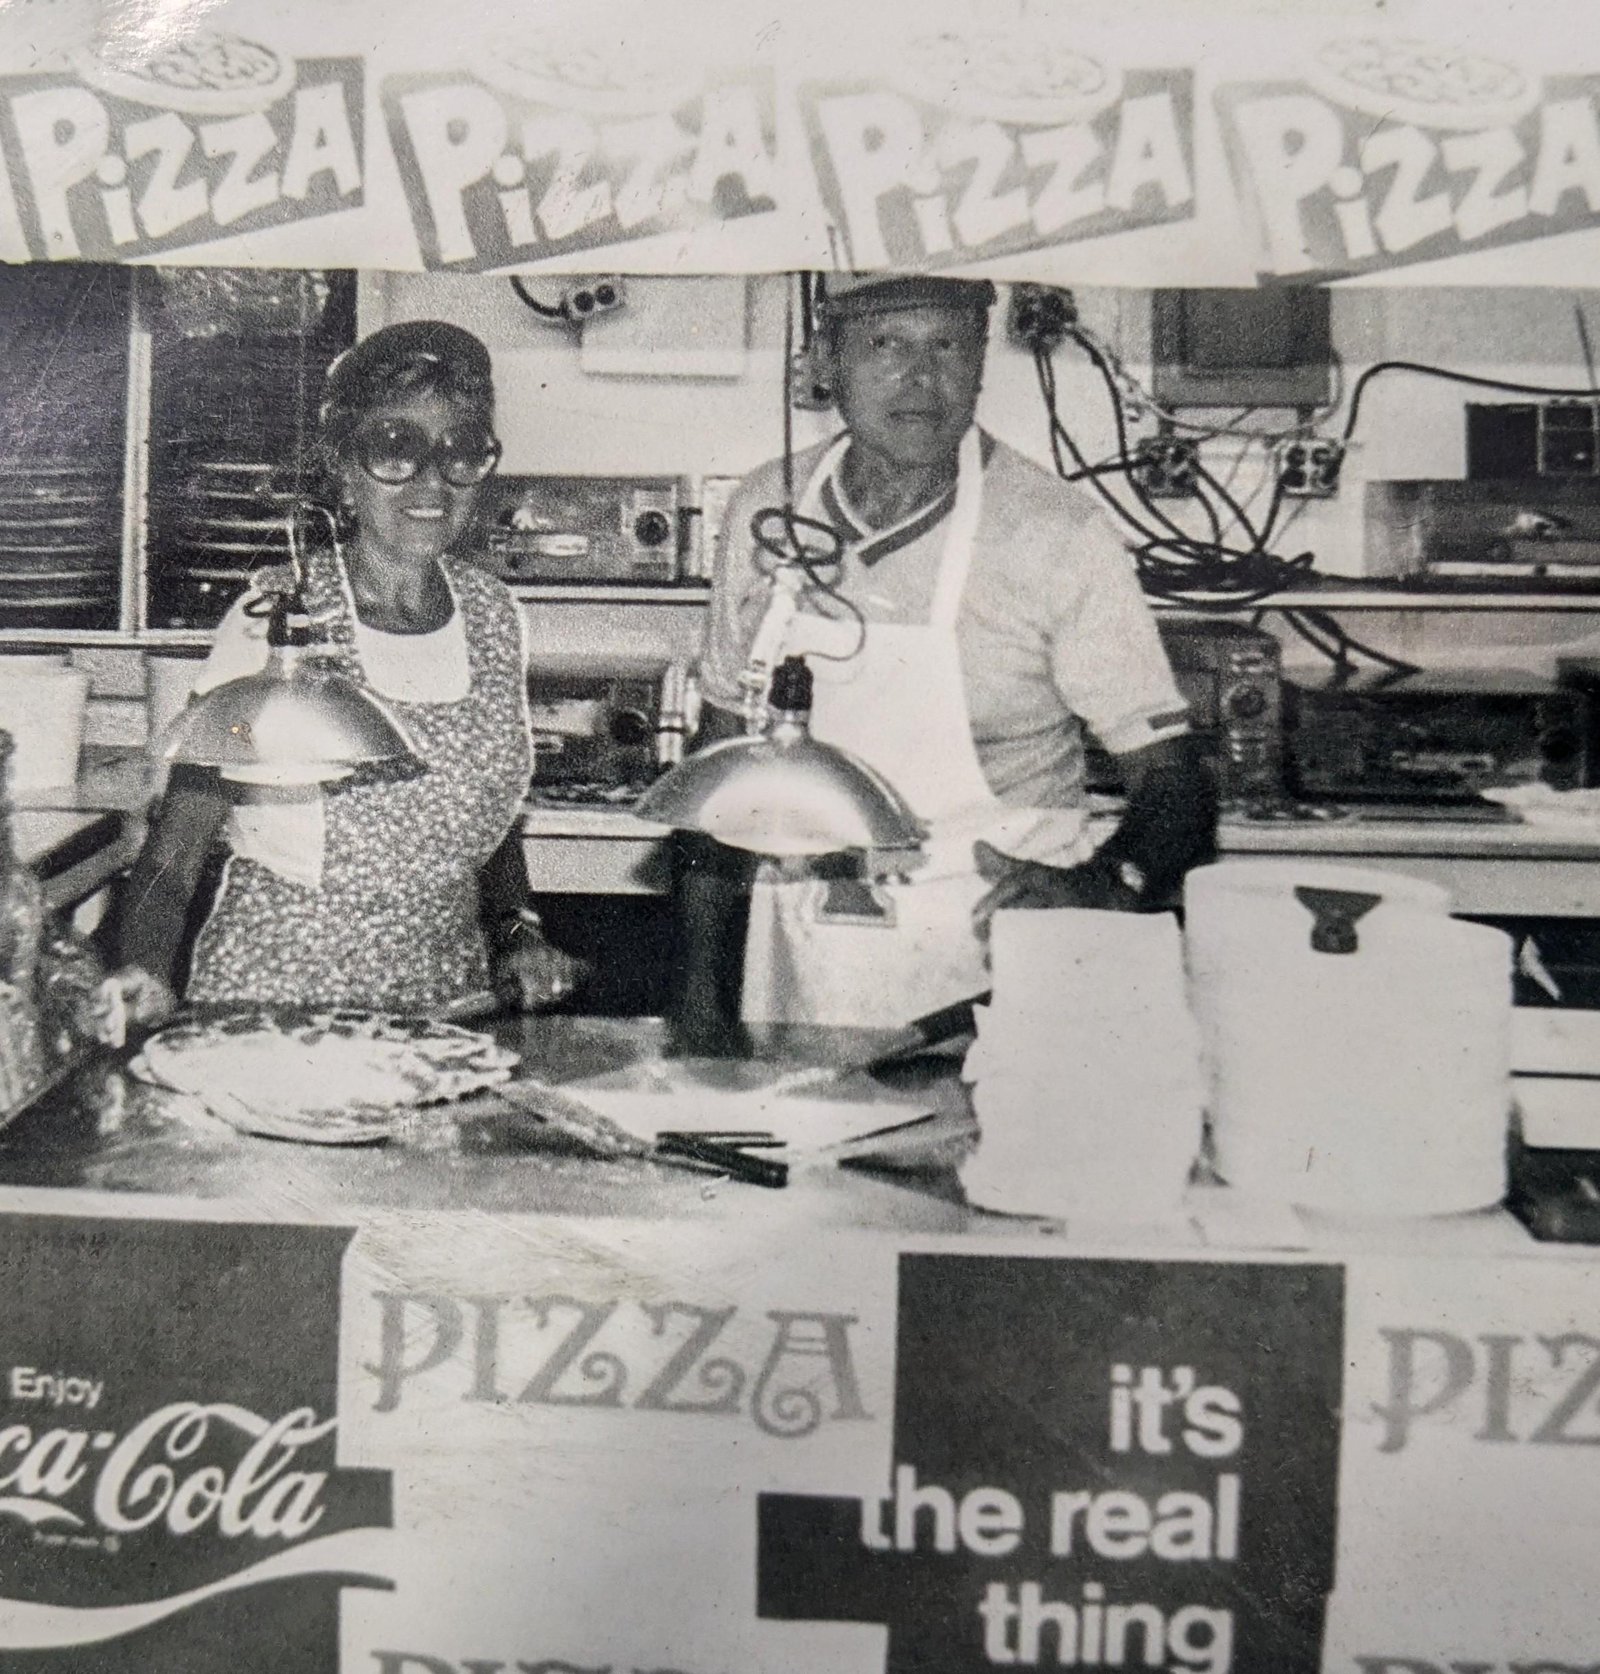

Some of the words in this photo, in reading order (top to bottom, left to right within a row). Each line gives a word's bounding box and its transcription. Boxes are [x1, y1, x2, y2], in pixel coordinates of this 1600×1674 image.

[11, 1367, 103, 1408] Enjoy
[364, 1290, 876, 1438] PIZZA
[858, 1463, 1025, 1557] the
[1050, 1472, 1241, 1561] real
[978, 1580, 1235, 1674] thing
